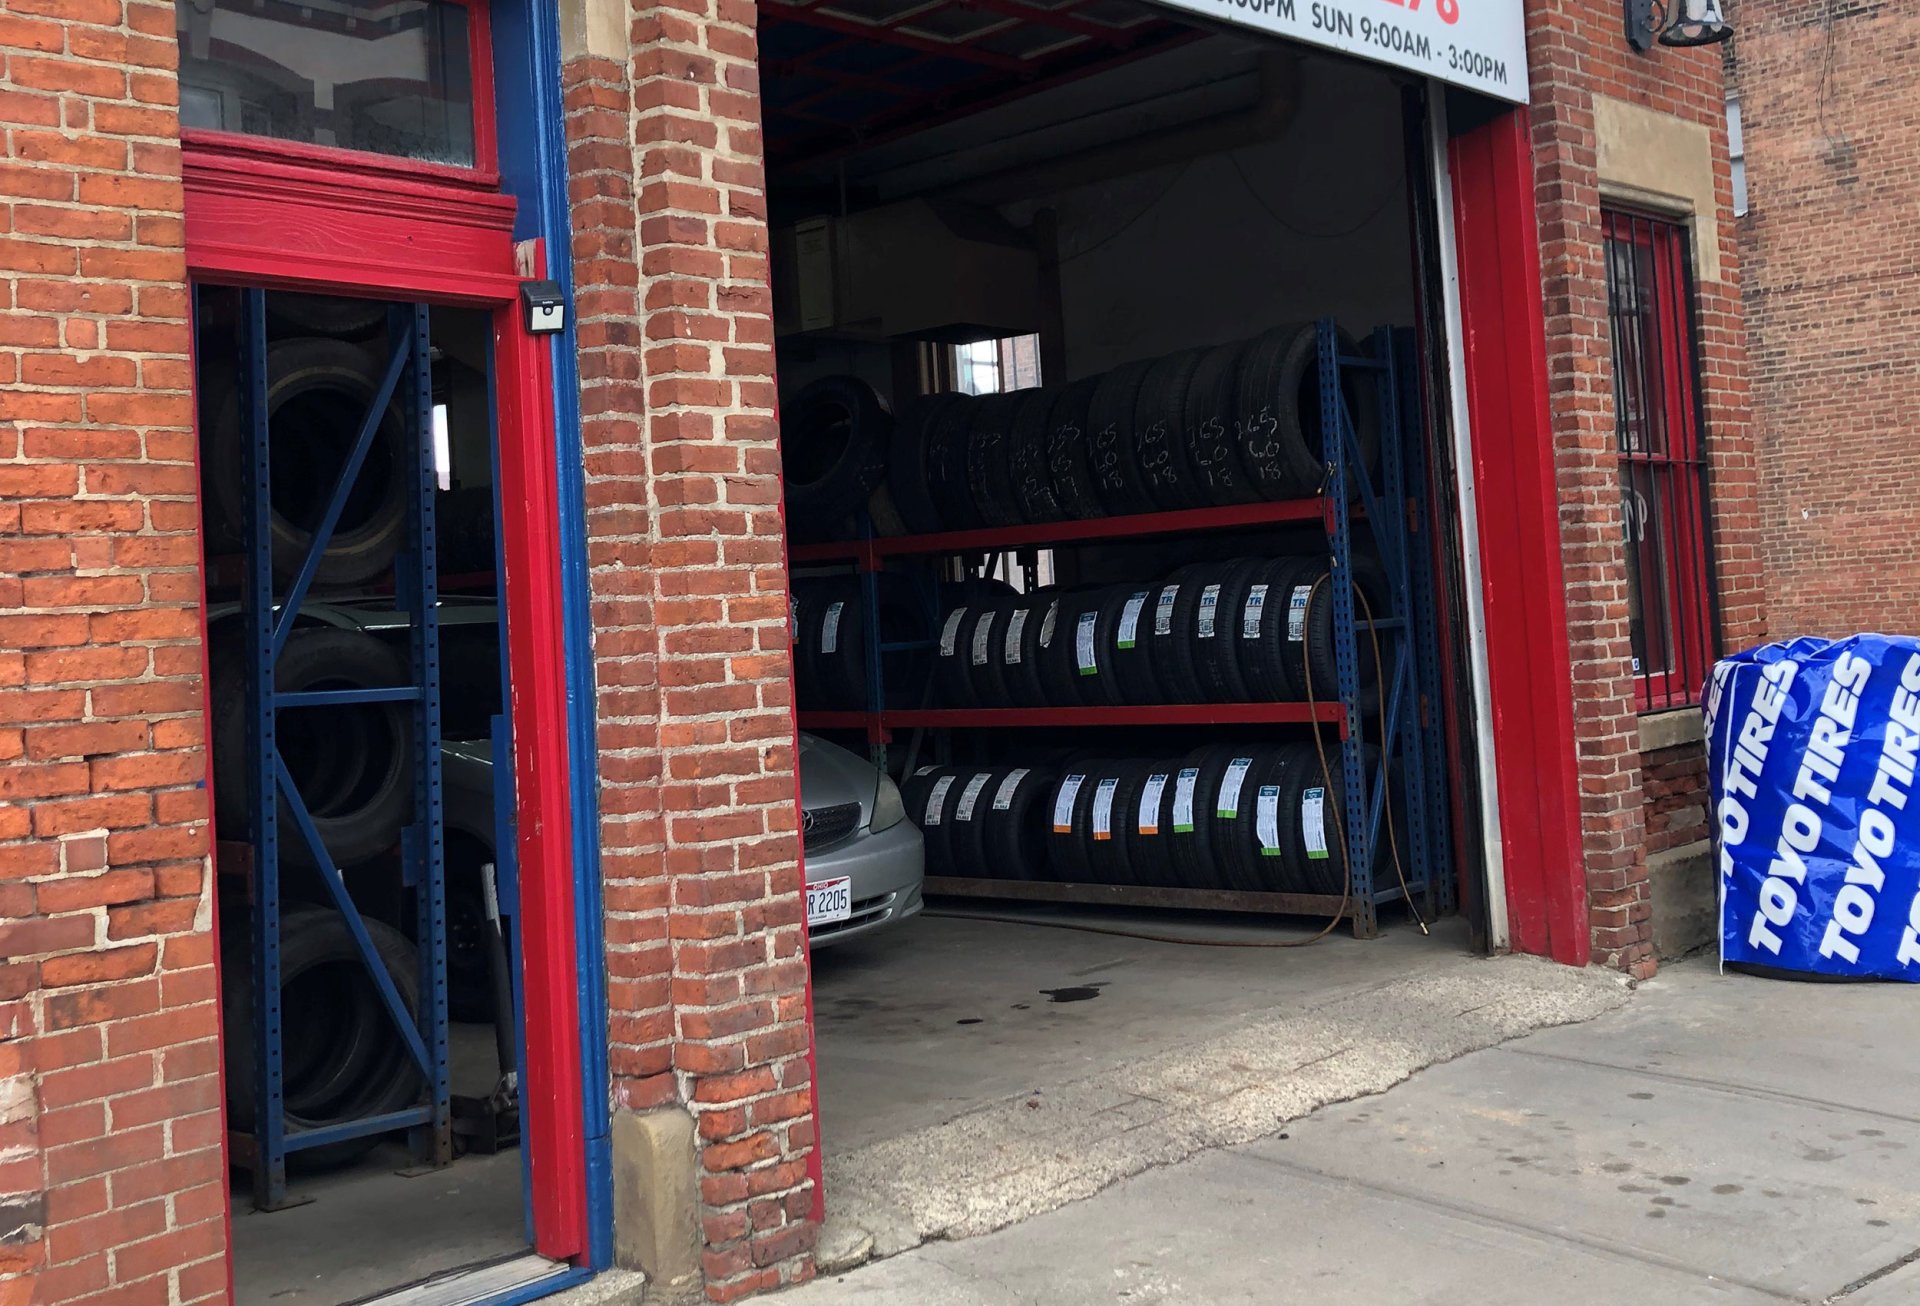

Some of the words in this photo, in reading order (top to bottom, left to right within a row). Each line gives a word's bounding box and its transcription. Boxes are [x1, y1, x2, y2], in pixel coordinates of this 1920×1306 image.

[1311, 2, 1354, 38] SUN
[1360, 16, 1432, 61] 9:00AM
[1448, 44, 1508, 85] 3:00PM
[1161, 596, 1173, 604] TR
[1203, 596, 1215, 605] TR
[1249, 597, 1262, 605] TR
[1293, 598, 1306, 607] TR
[1727, 659, 1799, 800] TIRES
[1749, 804, 1823, 956] TOYO
[1793, 651, 1872, 806] TIRES
[1818, 808, 1896, 965] TOYO
[819, 889, 847, 913] 2205
